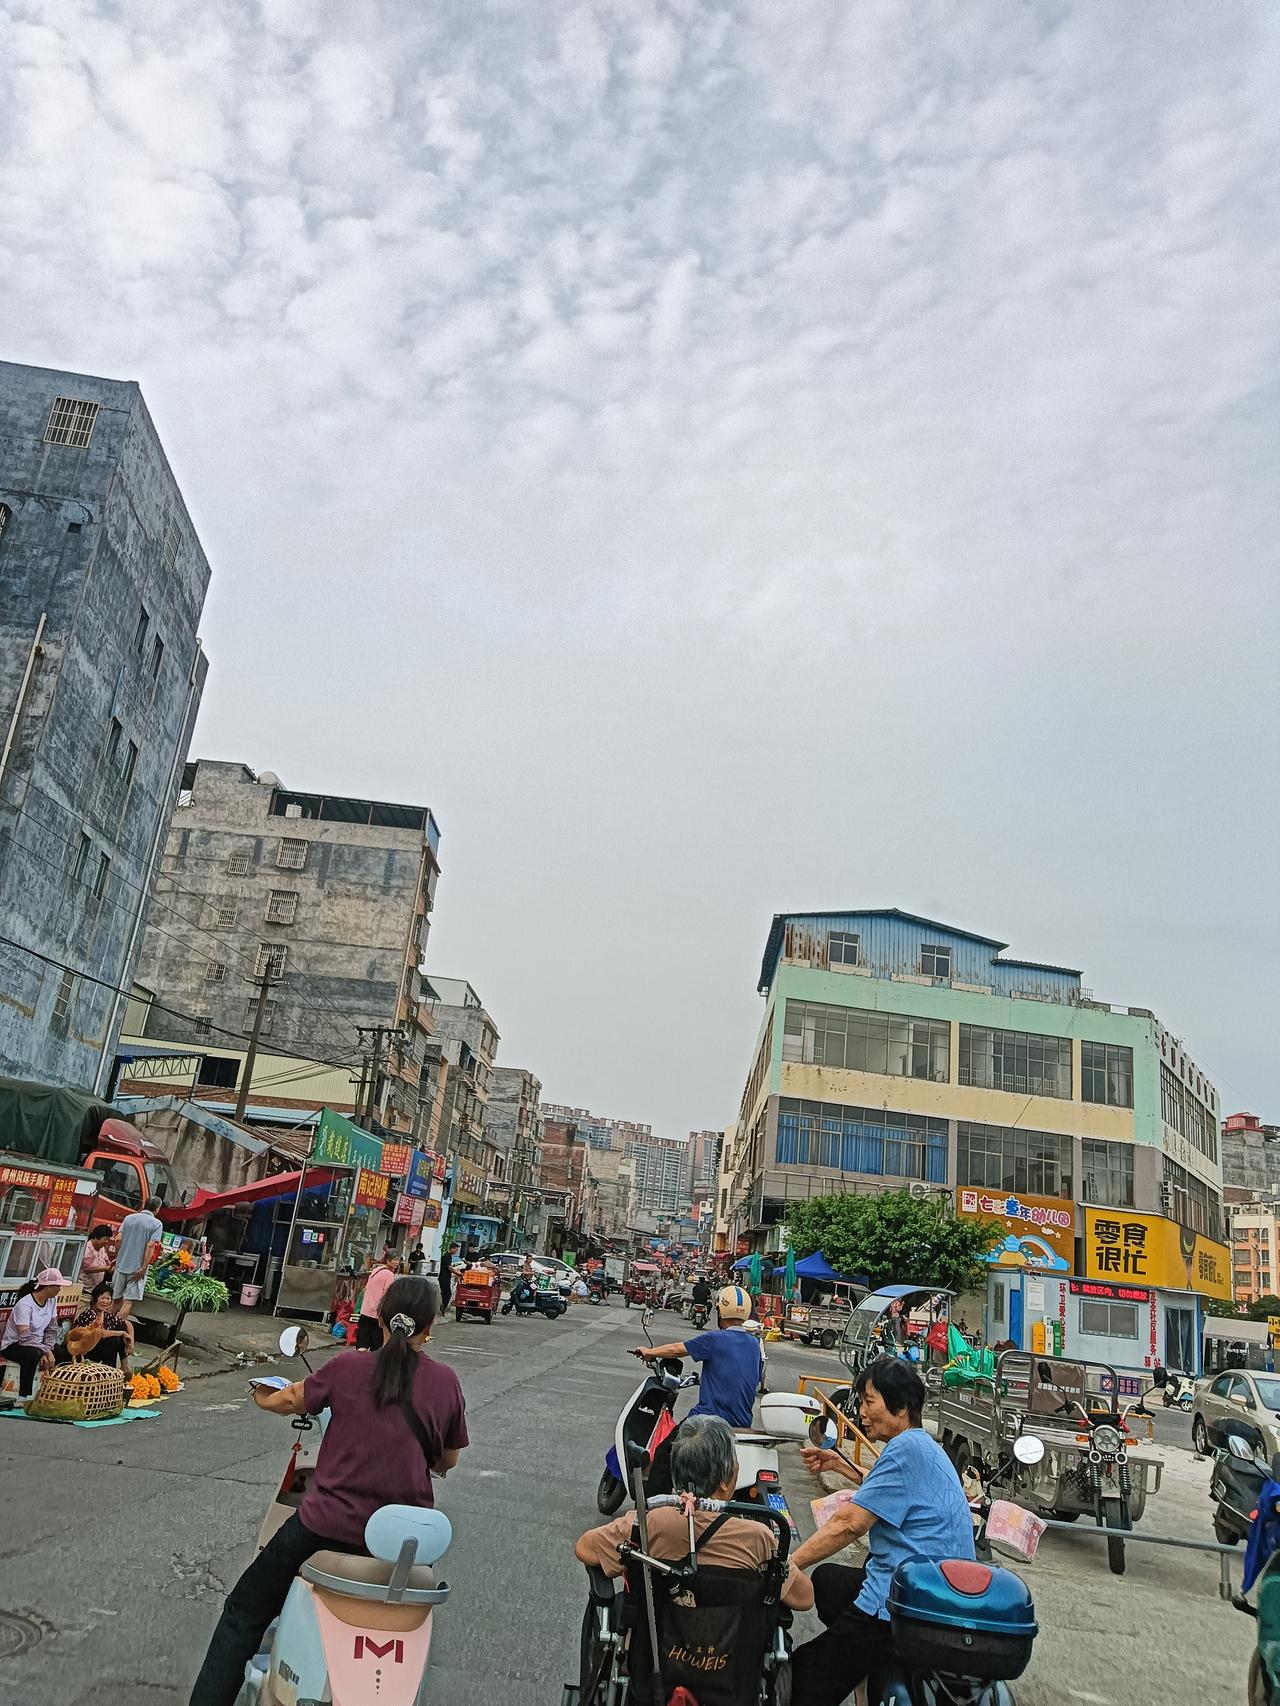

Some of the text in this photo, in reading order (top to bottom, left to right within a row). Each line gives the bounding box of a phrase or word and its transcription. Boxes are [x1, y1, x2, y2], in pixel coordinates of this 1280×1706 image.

[979, 1195, 1070, 1228] 七彩童年幼儿园
[1094, 1219, 1148, 1248] 零食
[1095, 1246, 1147, 1275] 很忙
[668, 1645, 729, 1671] HUWEIS
